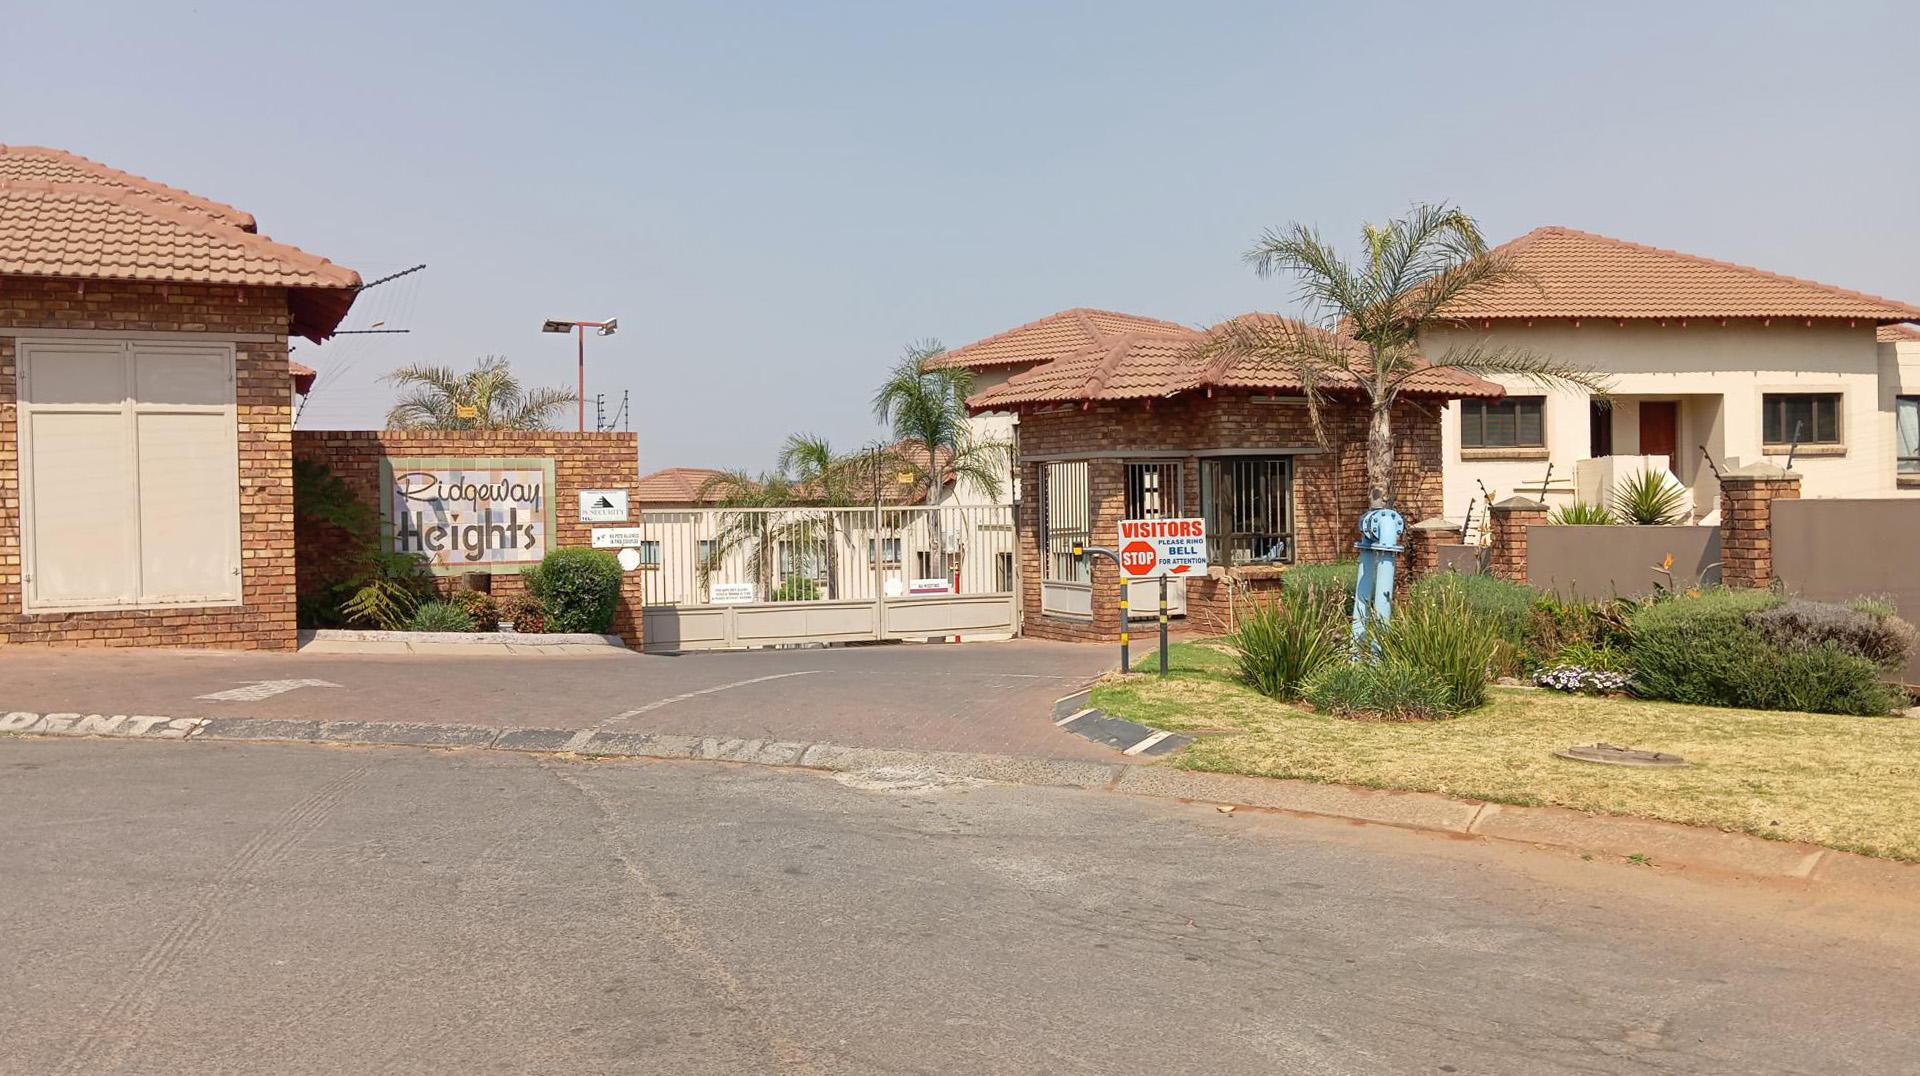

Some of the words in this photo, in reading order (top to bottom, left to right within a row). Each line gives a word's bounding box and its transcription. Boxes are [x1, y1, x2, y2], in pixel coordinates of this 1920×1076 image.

[397, 472, 540, 513] Ridgeway
[398, 507, 536, 562] Heights
[1121, 521, 1203, 538] VISITORS
[1122, 551, 1155, 566] STOP
[1168, 546, 1198, 555] BELL
[1172, 557, 1206, 565] ATTENTION
[0, 711, 212, 739] DENTS
